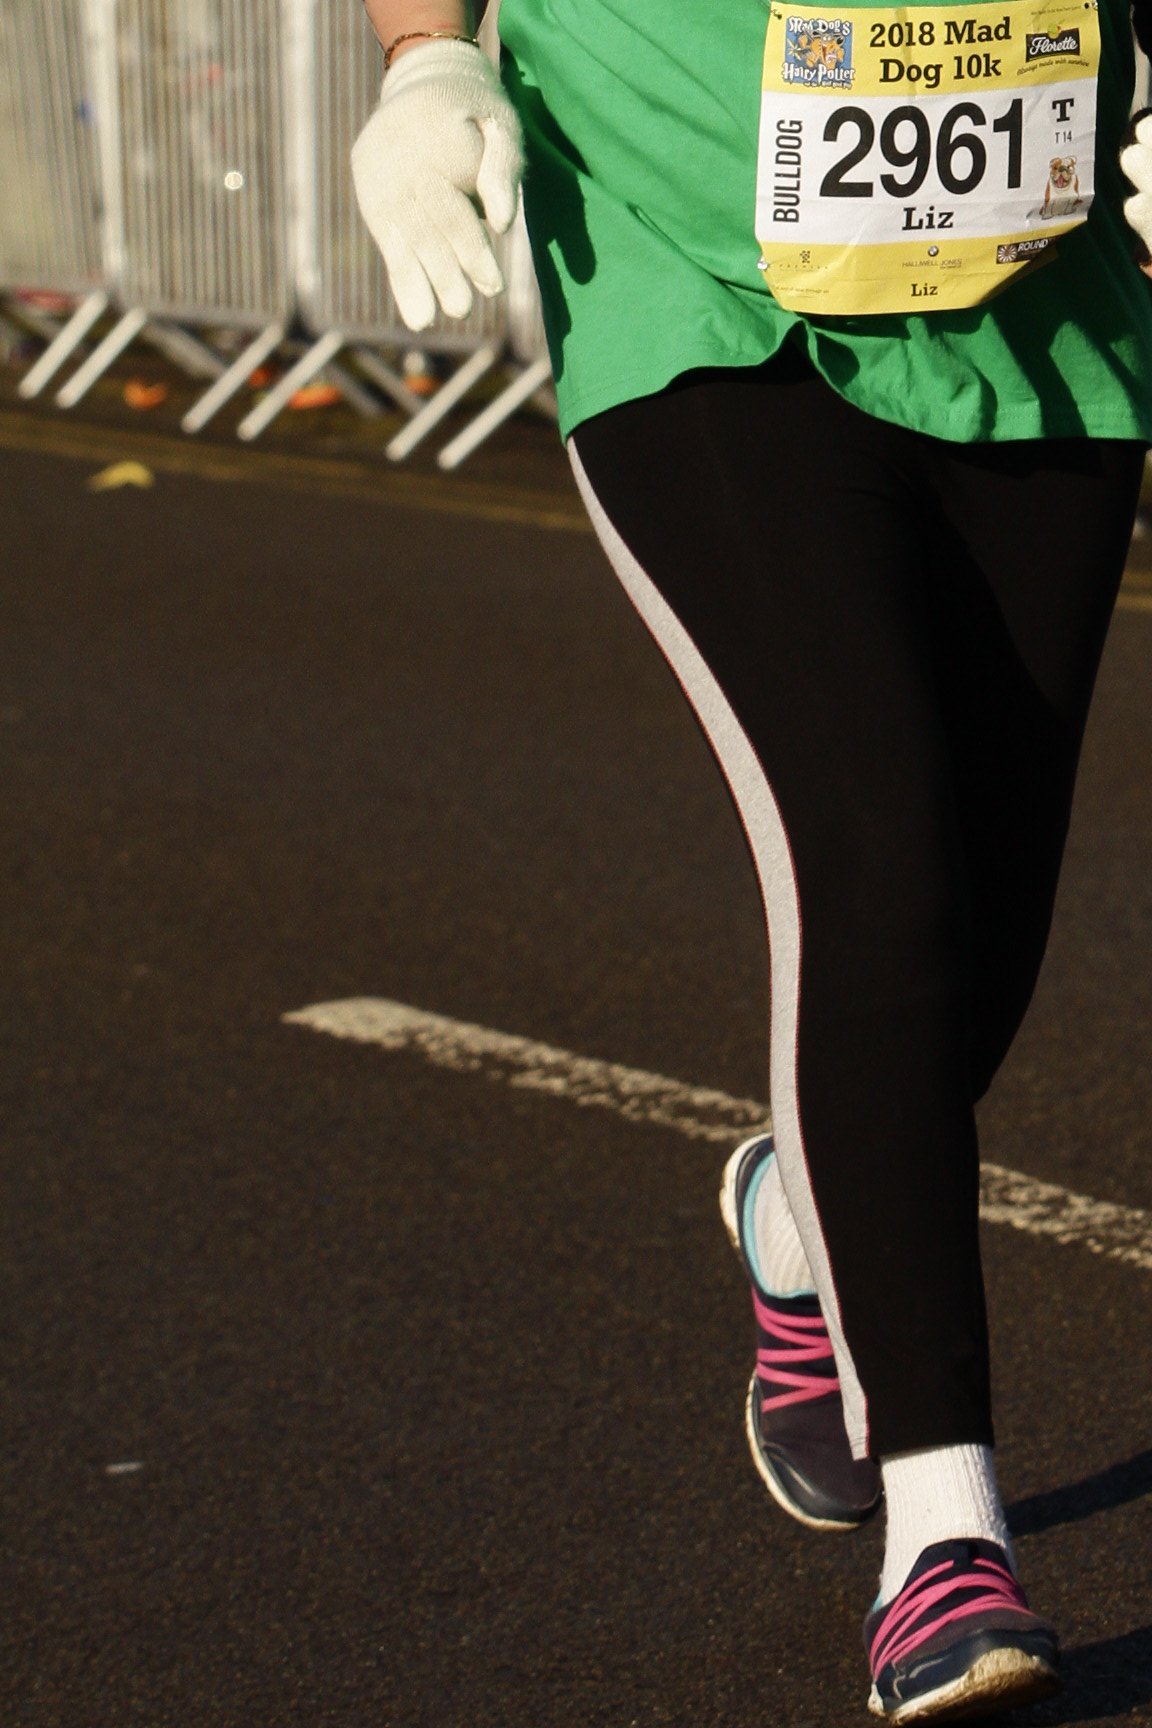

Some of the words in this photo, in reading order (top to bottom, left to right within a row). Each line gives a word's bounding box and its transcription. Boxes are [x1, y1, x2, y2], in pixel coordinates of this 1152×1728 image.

[870, 22, 935, 47] 2018
[944, 18, 1011, 45] Mad
[1029, 37, 1078, 55] Florette
[880, 60, 942, 88] Dog
[954, 54, 1001, 79] 10k
[1052, 98, 1074, 122] T
[819, 98, 1023, 197] 2961
[1055, 131, 1062, 143] T
[1063, 130, 1073, 142] 14
[774, 119, 803, 223] BULLDOG
[902, 206, 953, 231] Liz
[1018, 239, 1048, 252] ROUND
[911, 283, 938, 297] Liz
